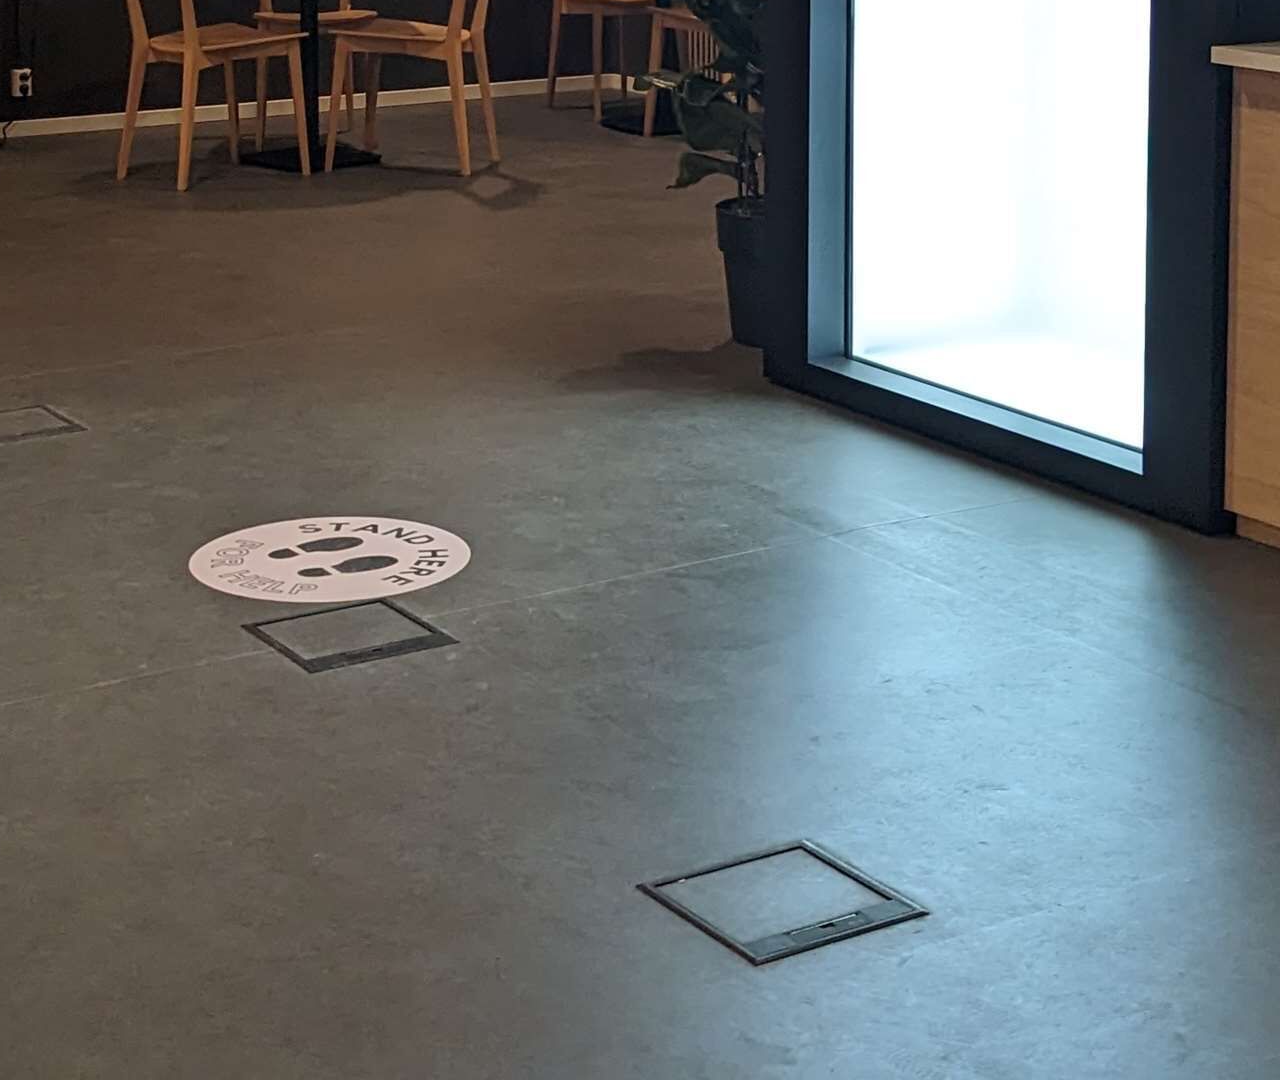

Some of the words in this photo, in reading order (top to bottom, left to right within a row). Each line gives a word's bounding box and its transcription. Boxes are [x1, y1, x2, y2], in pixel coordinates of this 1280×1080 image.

[210, 538, 265, 569] FOR
[298, 522, 435, 545] STAND
[381, 548, 449, 586] HERE
[220, 570, 320, 596] HELP
